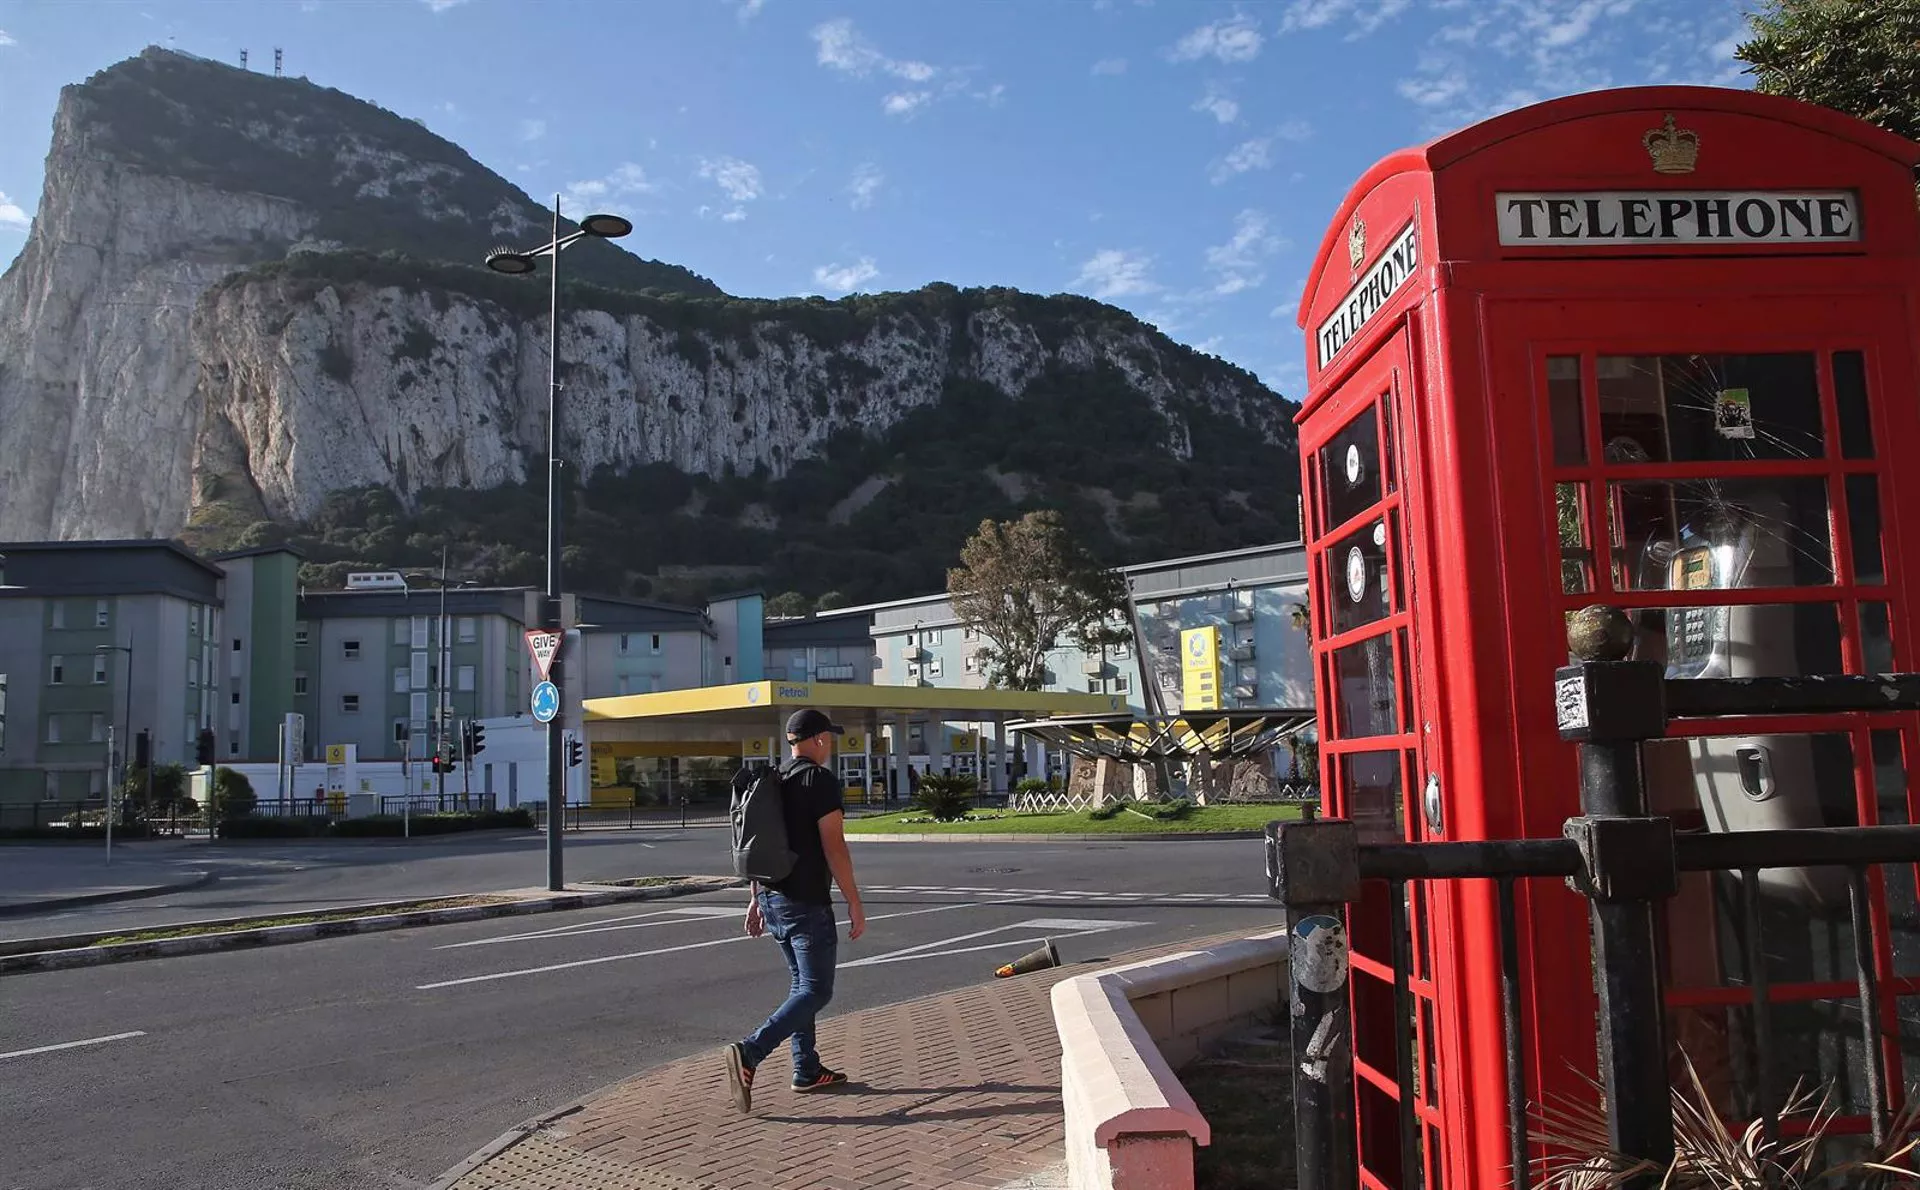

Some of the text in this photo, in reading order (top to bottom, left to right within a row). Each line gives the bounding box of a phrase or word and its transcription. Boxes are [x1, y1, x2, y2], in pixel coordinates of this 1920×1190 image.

[1508, 198, 1853, 239] TELEPHONE
[1323, 234, 1418, 358] TELEPHONE
[533, 635, 555, 649] GIVE
[537, 649, 550, 658] WAY
[779, 687, 808, 698] Petroil
